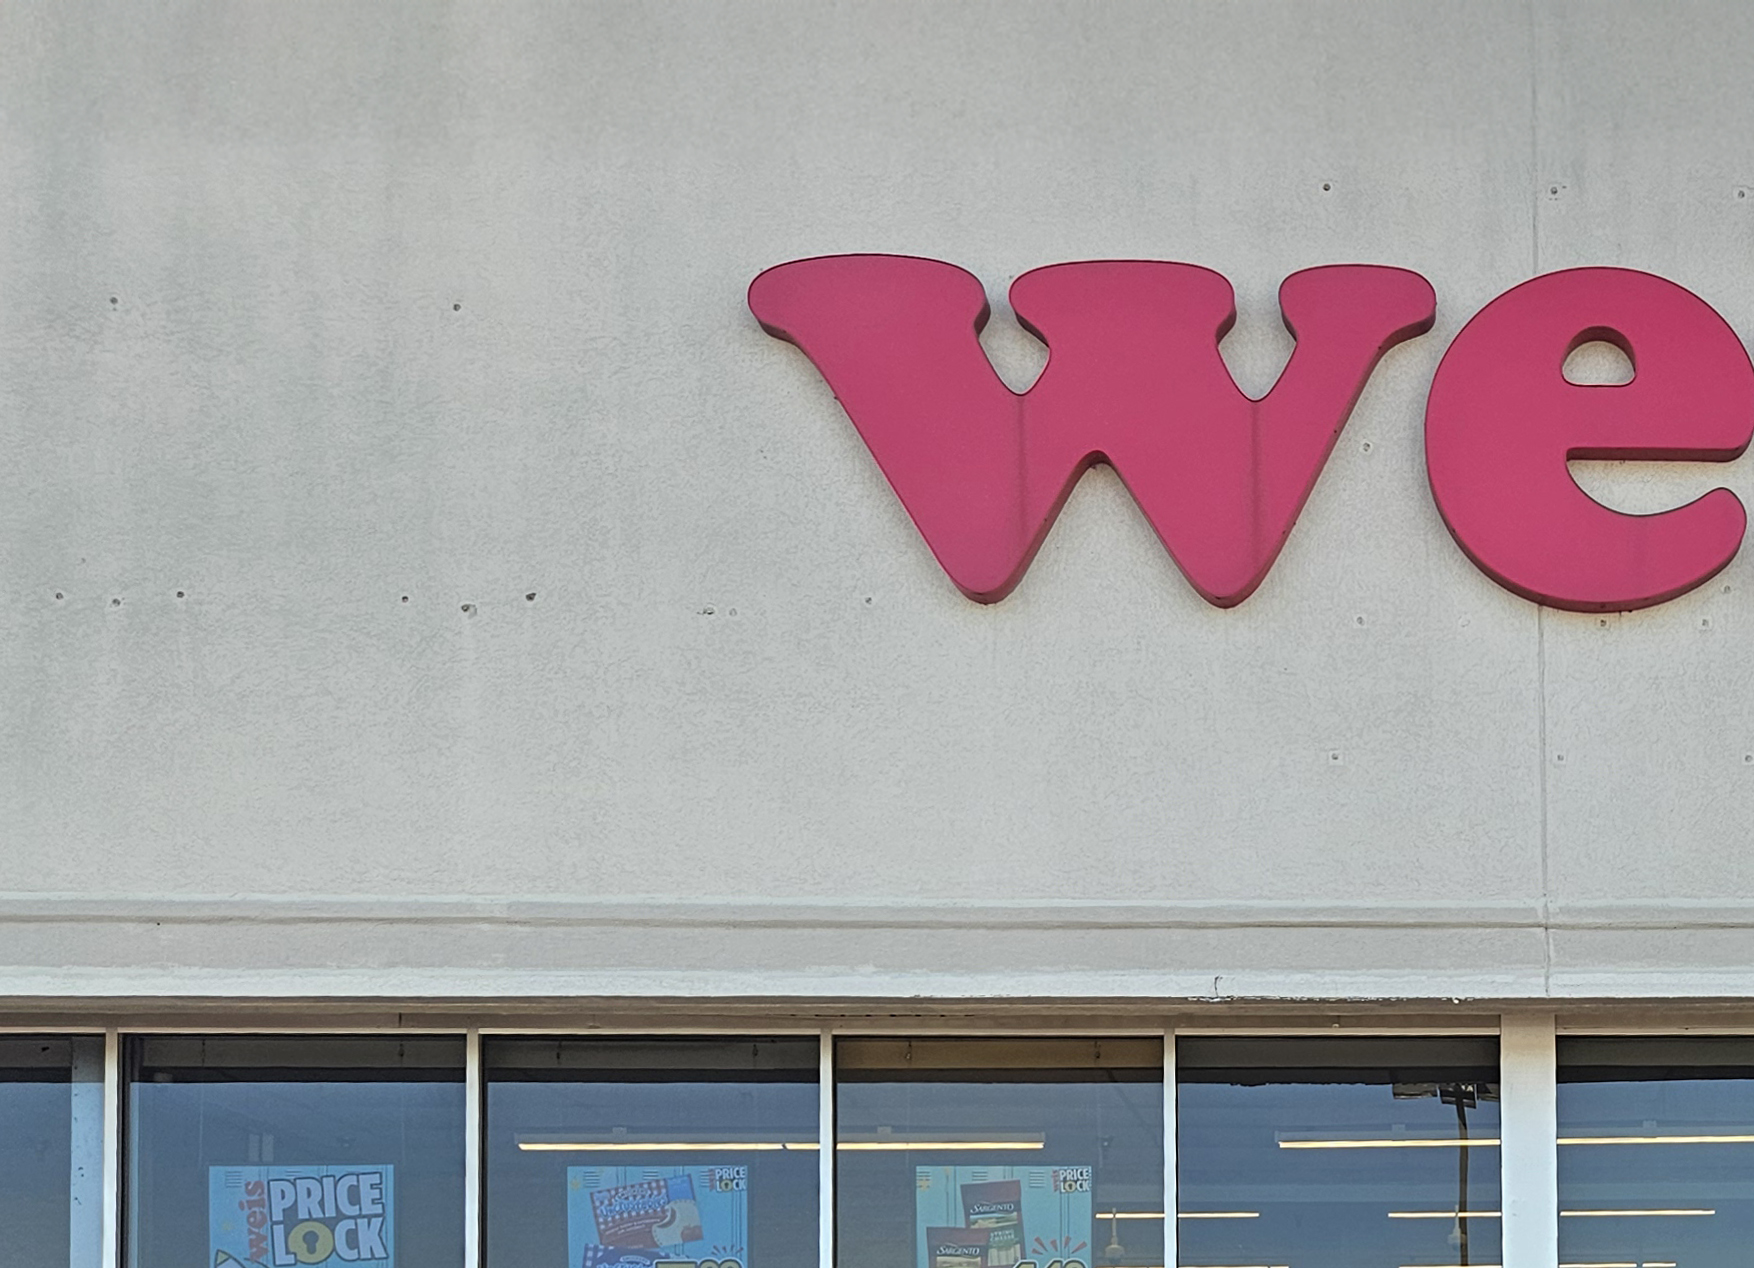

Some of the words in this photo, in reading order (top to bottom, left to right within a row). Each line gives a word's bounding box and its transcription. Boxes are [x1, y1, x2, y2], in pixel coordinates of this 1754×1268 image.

[715, 1167, 746, 1179] PRICE
[1059, 1168, 1090, 1180] PRICE
[268, 1171, 384, 1222] PRICE
[970, 1202, 1015, 1214] SARGENTO
[238, 1180, 270, 1264] weis
[270, 1216, 389, 1267] LOCK
[936, 1245, 980, 1255] SARGENTO
